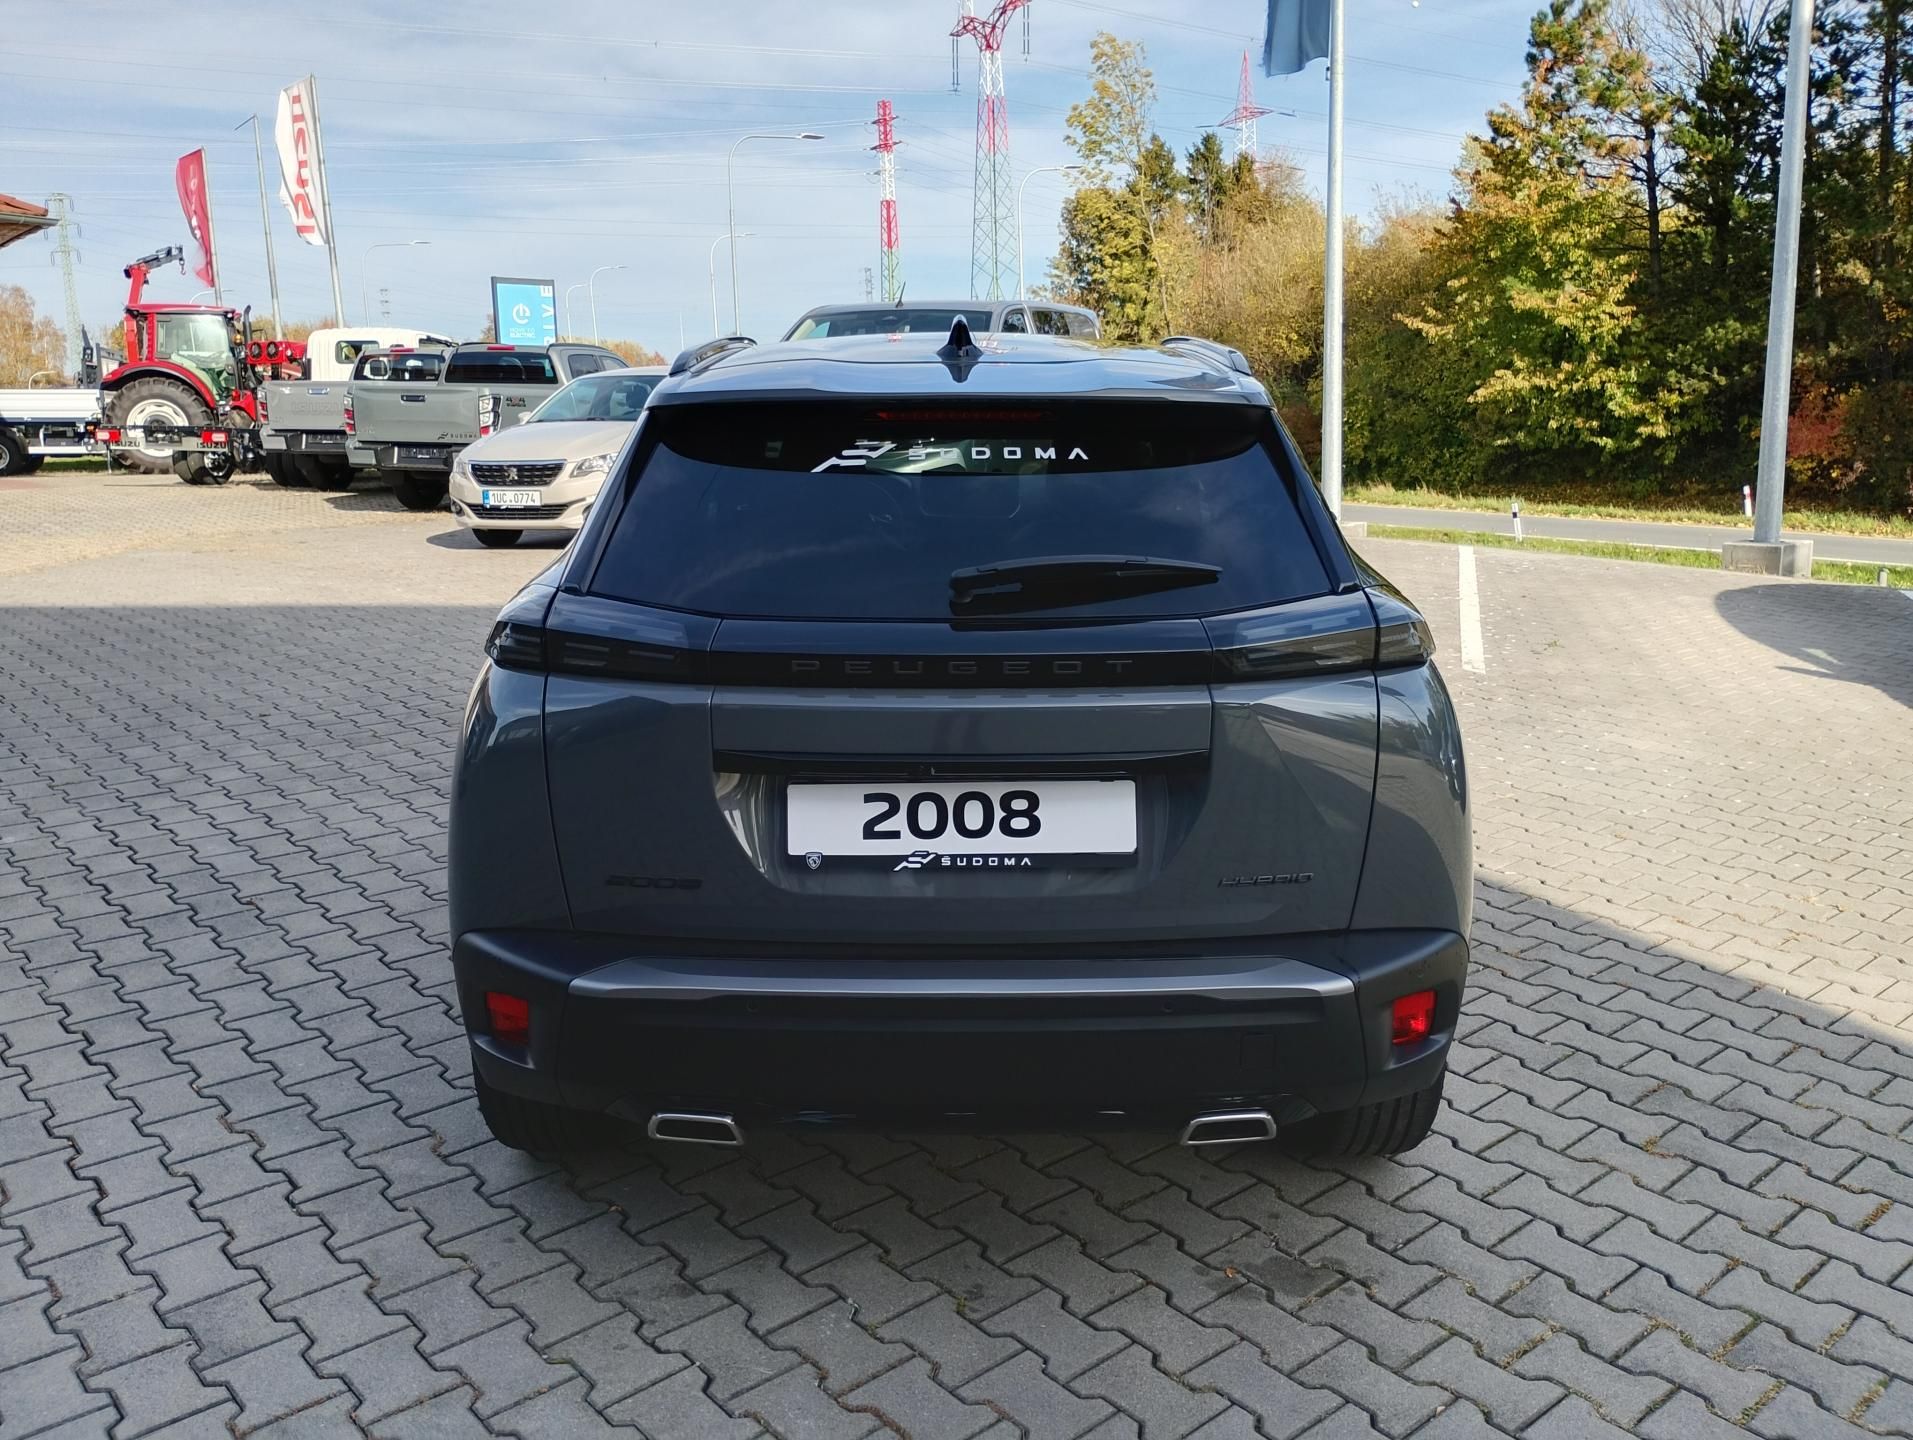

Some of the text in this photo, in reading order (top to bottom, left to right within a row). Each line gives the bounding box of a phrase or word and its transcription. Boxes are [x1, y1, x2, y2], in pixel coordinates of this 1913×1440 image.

[540, 285, 555, 345] RIVE
[196, 441, 227, 449] ISUZU
[791, 659, 1134, 675] PEUGEOT
[862, 789, 1042, 841] 2008
[941, 856, 1032, 866] ŠUDOMA
